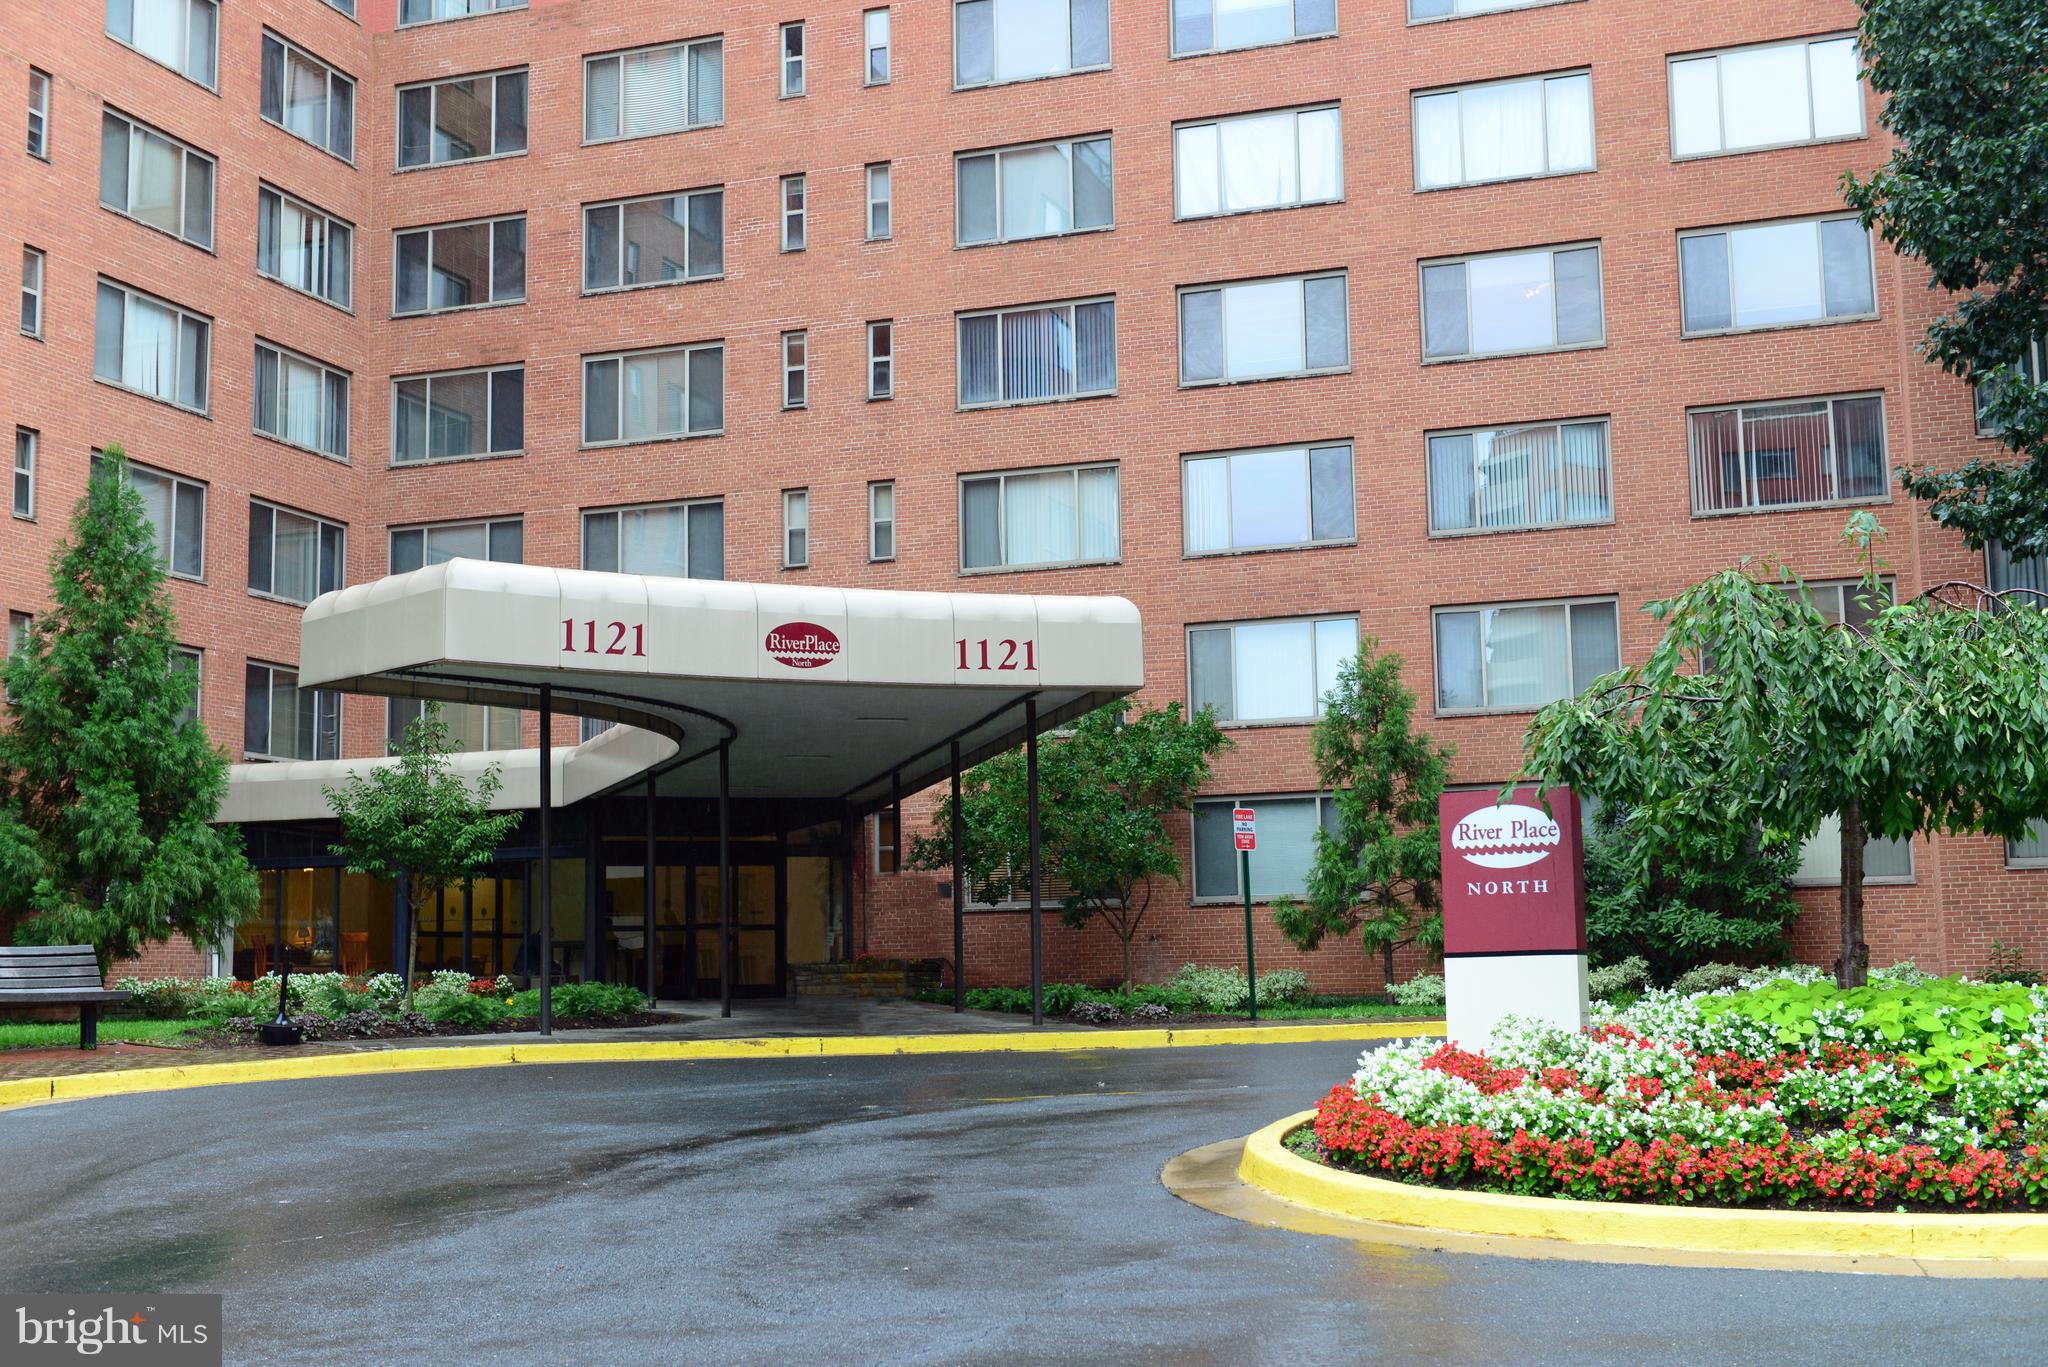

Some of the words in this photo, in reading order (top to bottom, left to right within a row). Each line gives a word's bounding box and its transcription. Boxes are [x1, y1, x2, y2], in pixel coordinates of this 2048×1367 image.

[561, 618, 647, 657] 1121
[769, 633, 840, 652] RiverPlace
[792, 658, 812, 667] North
[955, 638, 1038, 671] 1121
[1458, 823, 1502, 841] River
[1511, 819, 1557, 839] Place
[1467, 880, 1549, 896] NORTH
